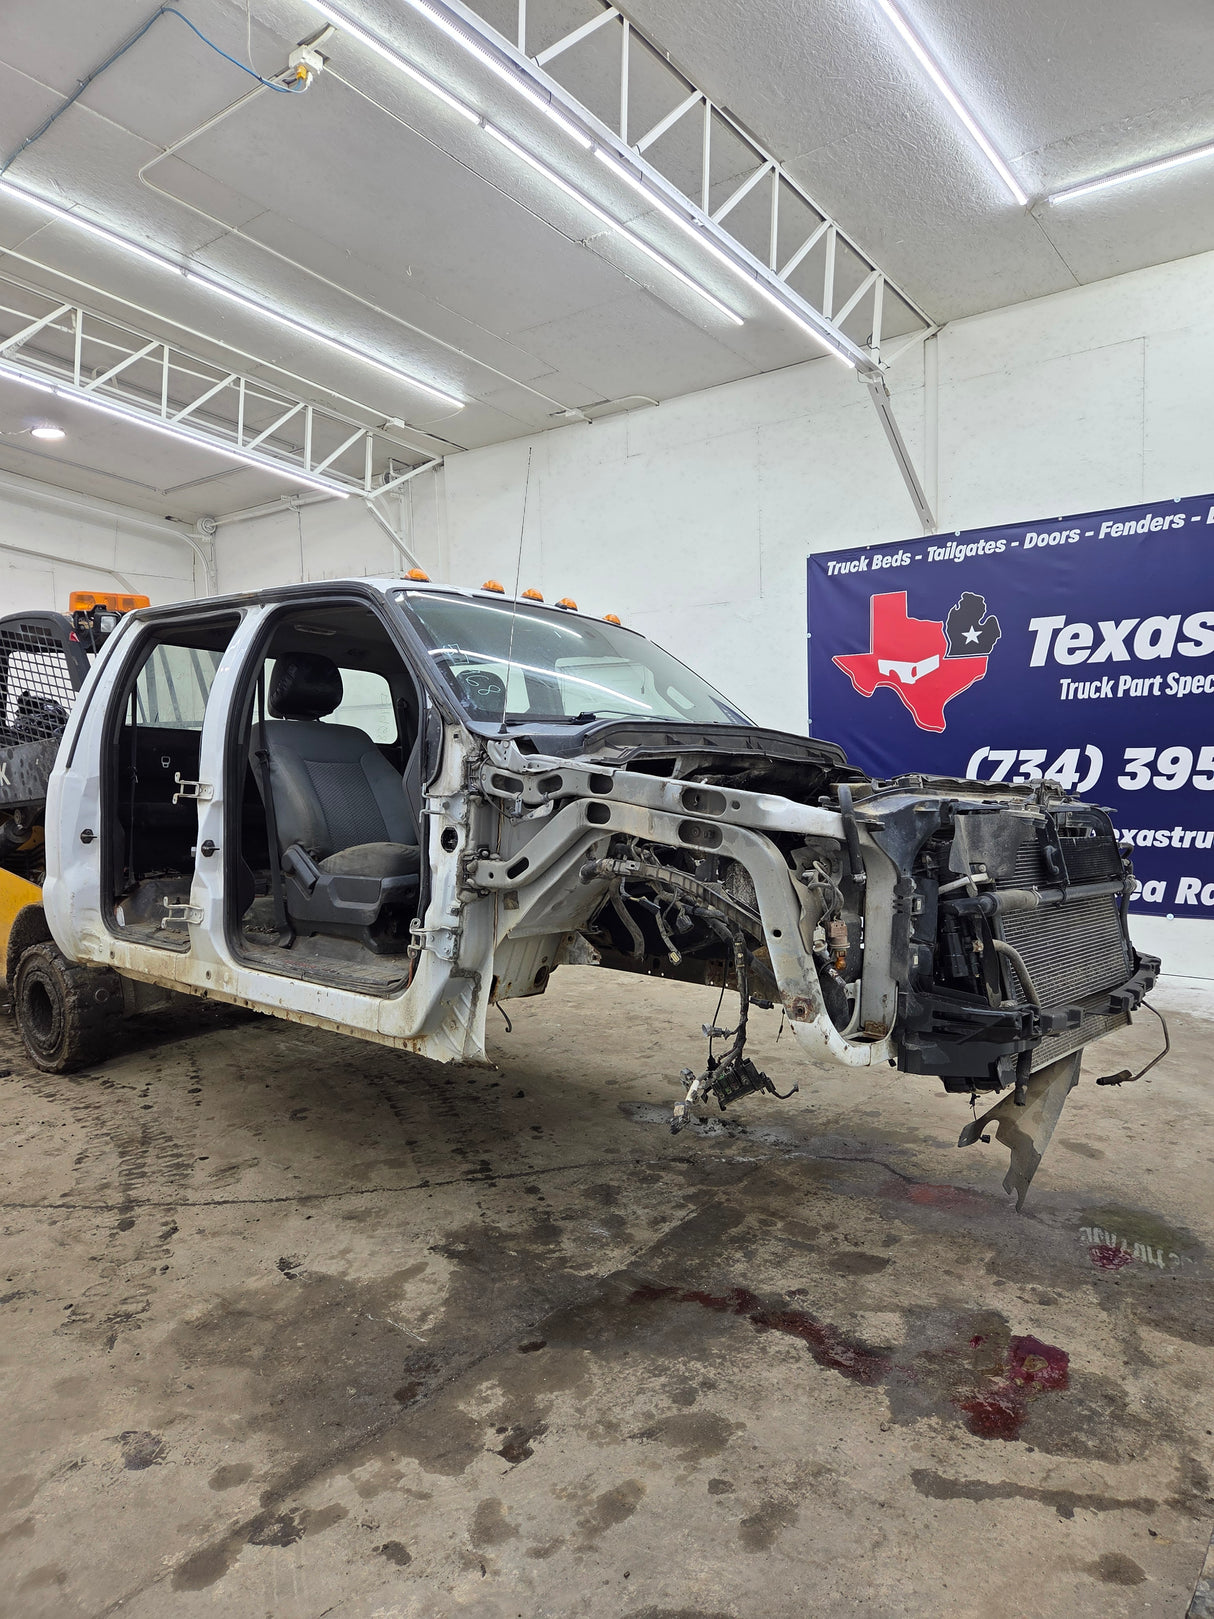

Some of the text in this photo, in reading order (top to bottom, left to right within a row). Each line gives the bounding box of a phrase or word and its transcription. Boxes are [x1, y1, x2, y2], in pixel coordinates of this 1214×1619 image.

[826, 555, 870, 576] Truck
[871, 549, 912, 571] Beds
[926, 538, 1007, 563] Tailgates
[1023, 528, 1081, 549] Doors
[1098, 513, 1187, 539] Fenders
[1028, 611, 1214, 668] Texas
[1059, 671, 1214, 700] Truck Part Spec
[965, 743, 1214, 794] (734) 395
